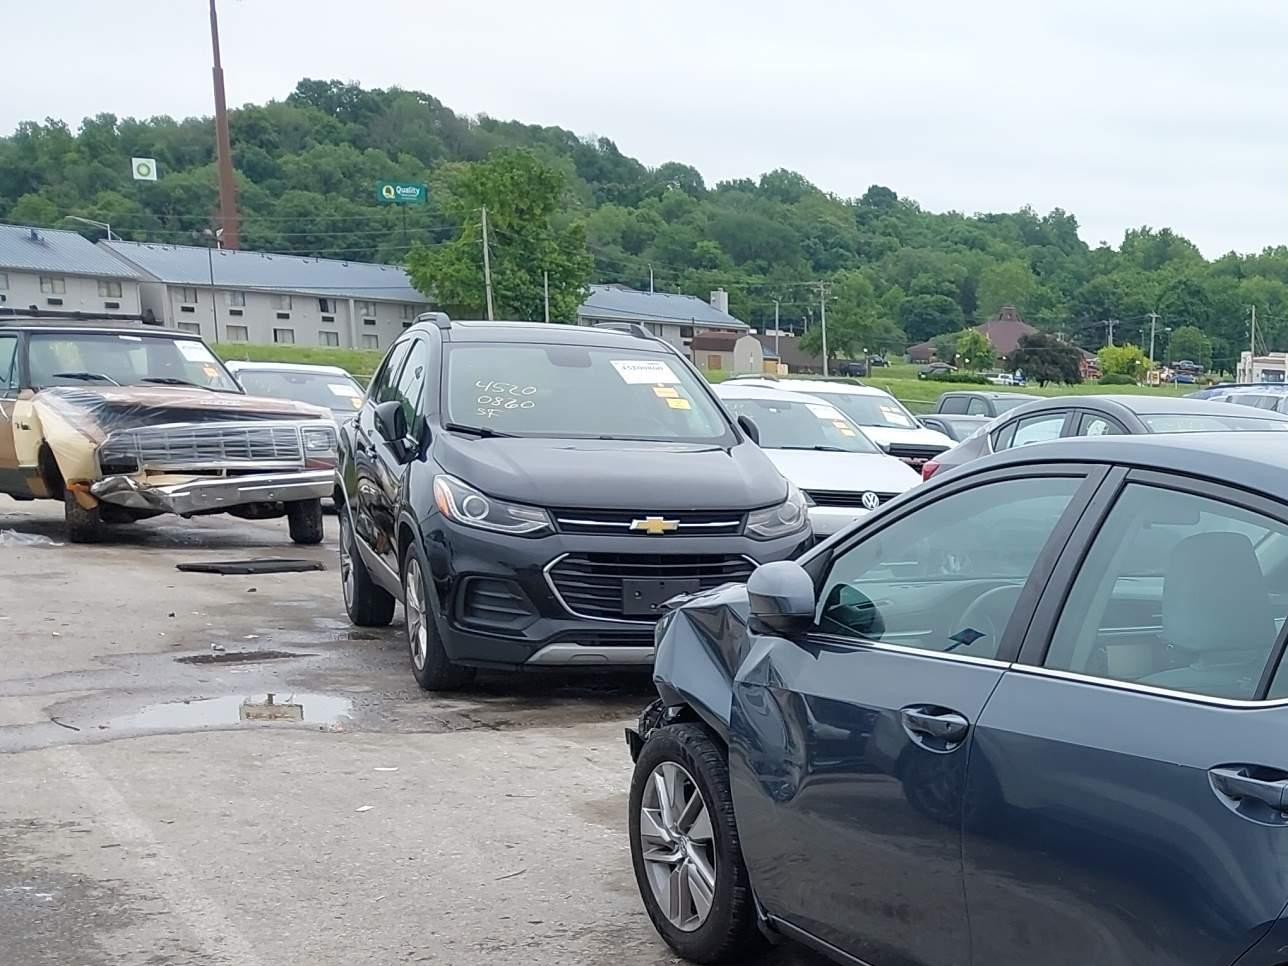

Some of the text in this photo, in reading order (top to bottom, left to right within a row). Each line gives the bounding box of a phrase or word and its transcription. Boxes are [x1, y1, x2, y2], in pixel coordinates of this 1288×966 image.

[396, 185, 420, 196] Quality
[475, 380, 537, 396] 4520
[477, 395, 535, 409] 0860
